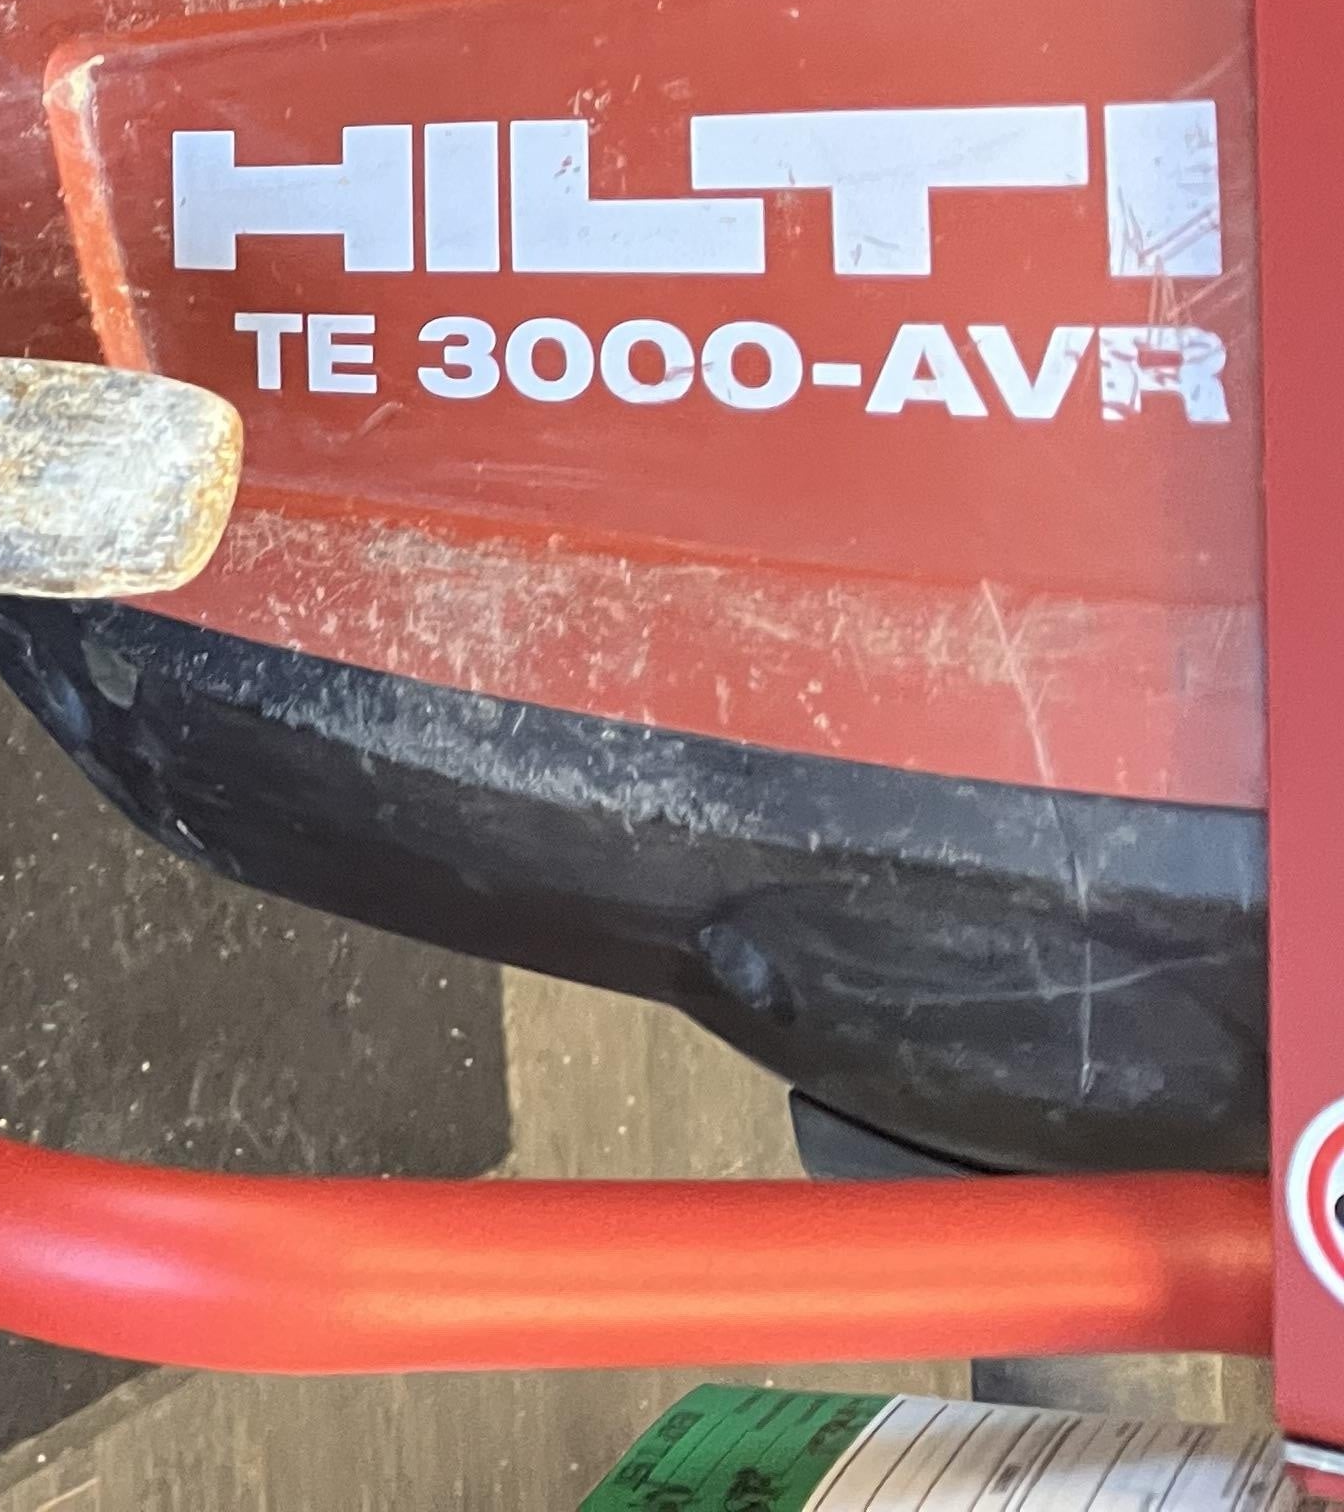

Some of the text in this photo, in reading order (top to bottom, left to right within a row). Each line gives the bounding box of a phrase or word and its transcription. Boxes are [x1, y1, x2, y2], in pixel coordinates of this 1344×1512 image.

[172, 100, 1223, 276] HILTI
[234, 312, 1231, 424] TE 3000-AVR
